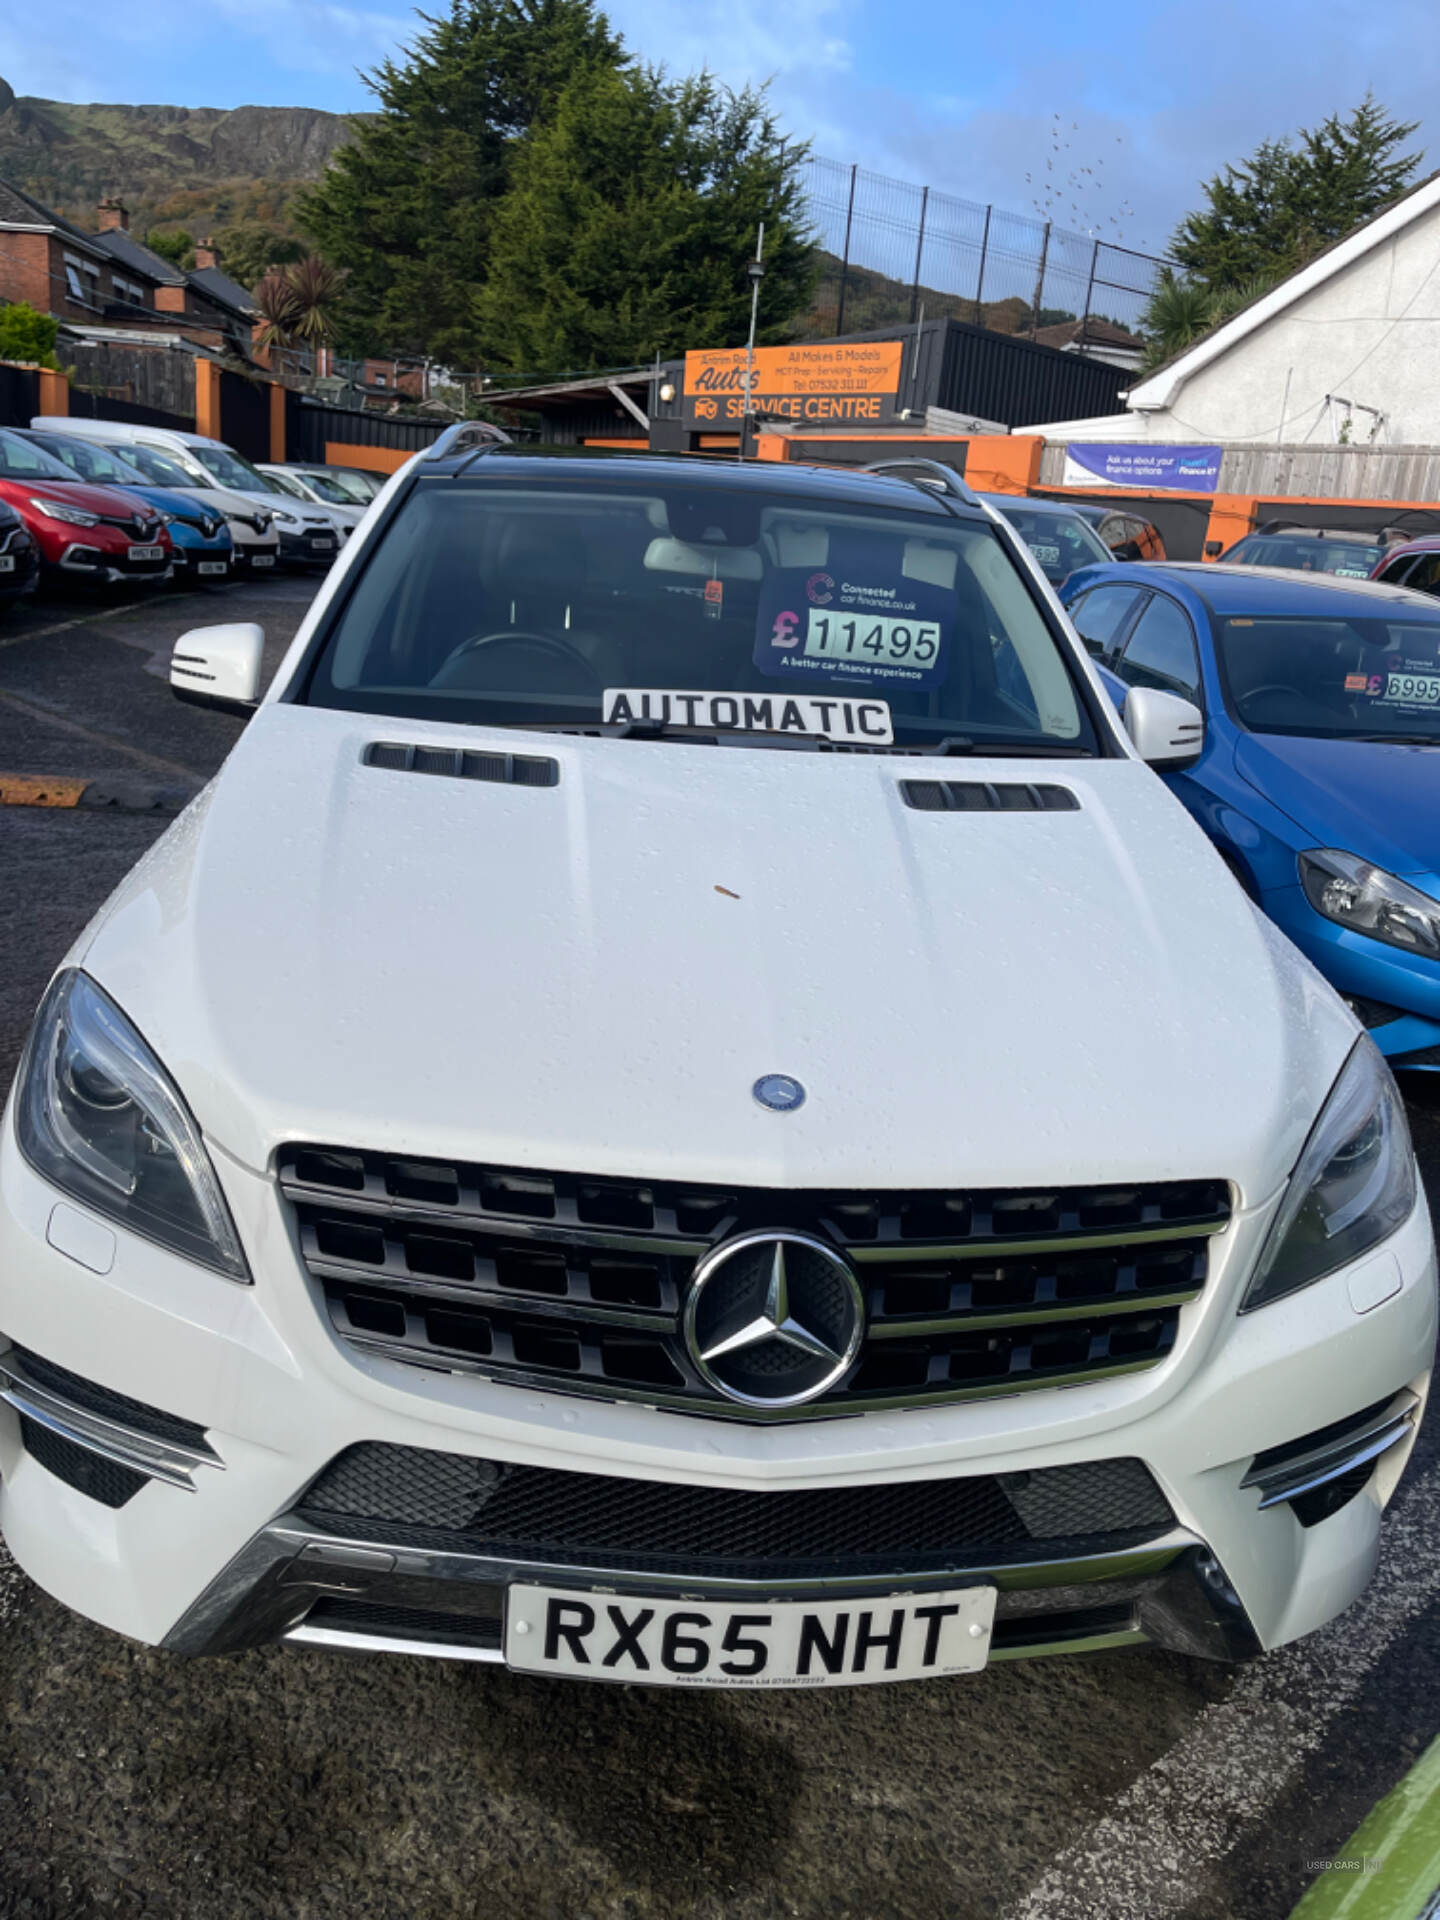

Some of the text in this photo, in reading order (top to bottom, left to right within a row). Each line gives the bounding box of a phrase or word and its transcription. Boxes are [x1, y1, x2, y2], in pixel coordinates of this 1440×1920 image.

[788, 351, 800, 362] All
[802, 351, 833, 362] Makes
[845, 349, 881, 361] Models
[695, 366, 760, 391] Autos
[817, 366, 852, 378] Servicing
[859, 365, 888, 375] Repairs
[726, 398, 882, 418] SERVICE CENTRE
[1106, 455, 1121, 464] Ask
[1133, 456, 1155, 465] about
[1156, 457, 1175, 467] your
[1106, 465, 1163, 476] finance options
[840, 595, 855, 604] car
[841, 582, 896, 599] Connected
[771, 611, 936, 661] £ 11495
[781, 656, 922, 680] A better car finance experience
[1365, 674, 1382, 696] £
[1388, 677, 1439, 700] 6995
[608, 693, 888, 736] AUTOMATIC
[543, 1597, 960, 1676] RX65 NHT
